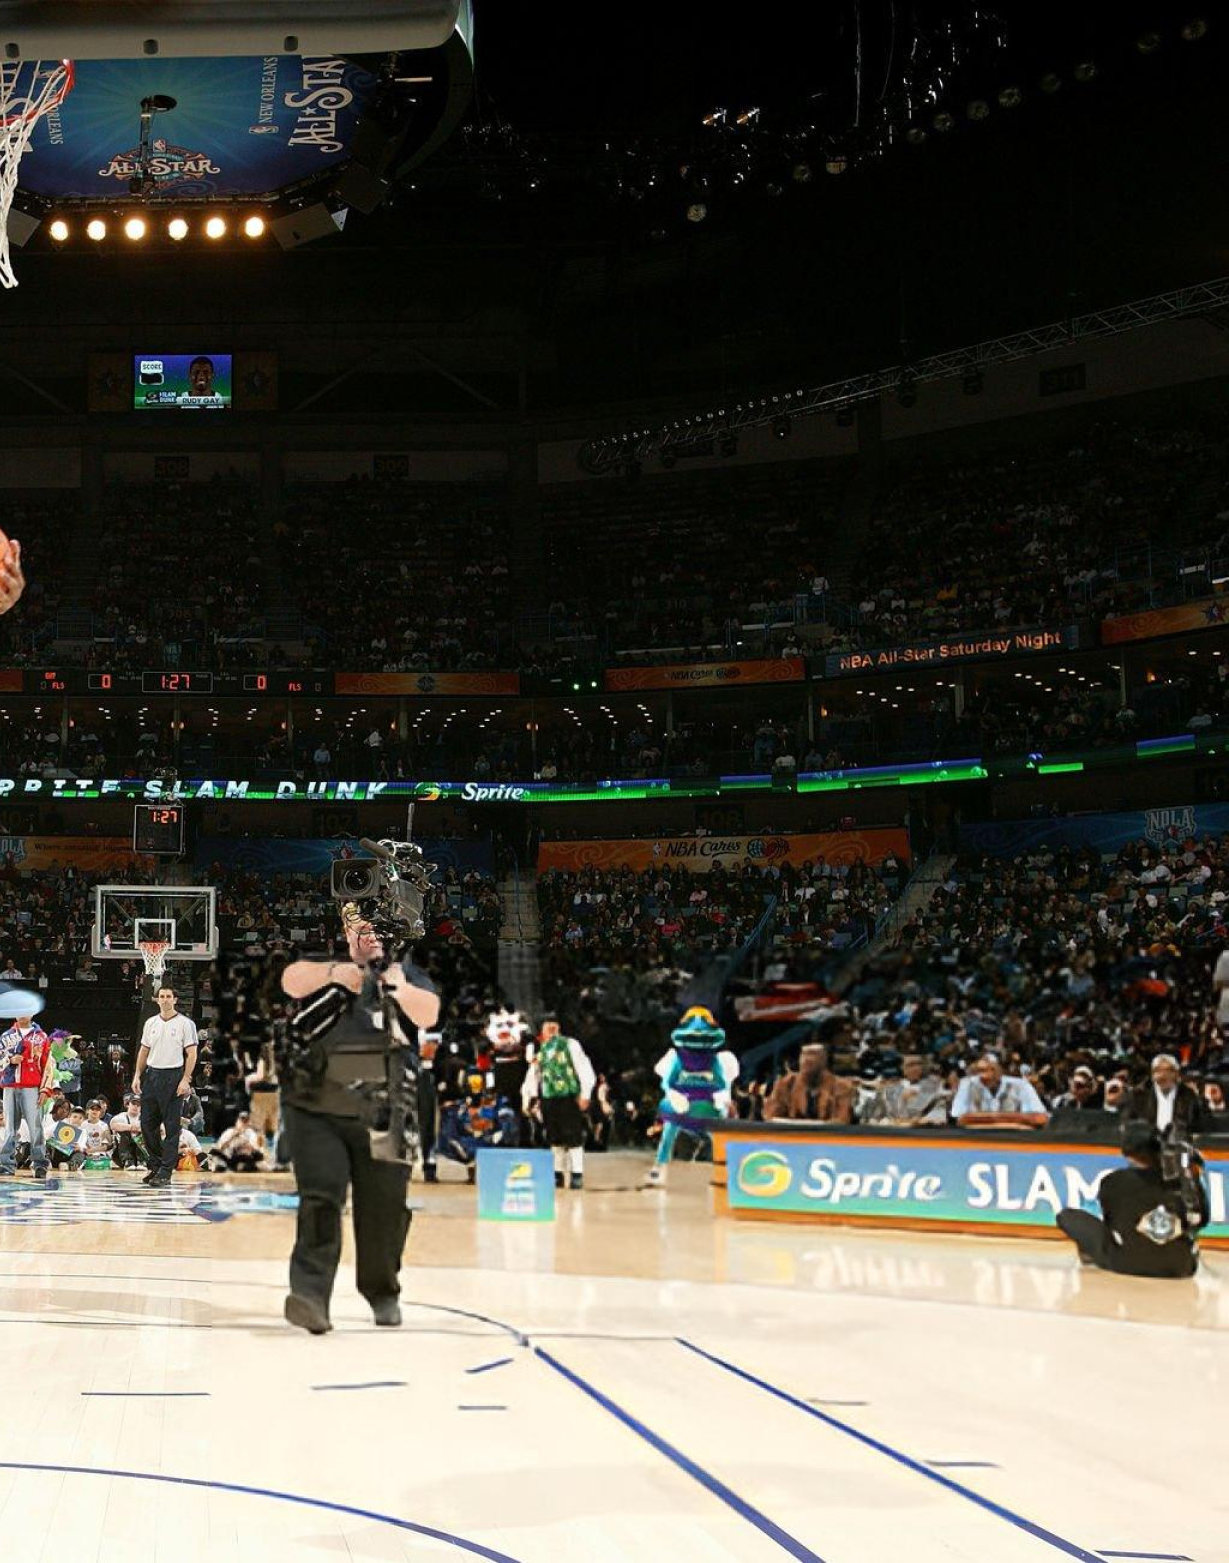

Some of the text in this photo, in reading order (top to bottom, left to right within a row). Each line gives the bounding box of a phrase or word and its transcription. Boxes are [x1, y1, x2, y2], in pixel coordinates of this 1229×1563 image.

[259, 57, 279, 123] NEW ORLEANS
[840, 631, 1062, 670] NBA All-Star Saturday Night
[161, 674, 190, 690] 1:27
[274, 781, 388, 800] DUNK
[461, 782, 521, 802] Sprite
[152, 811, 178, 824] 1:27
[665, 840, 742, 858] NBA Cares
[801, 1157, 941, 1204] Sprite
